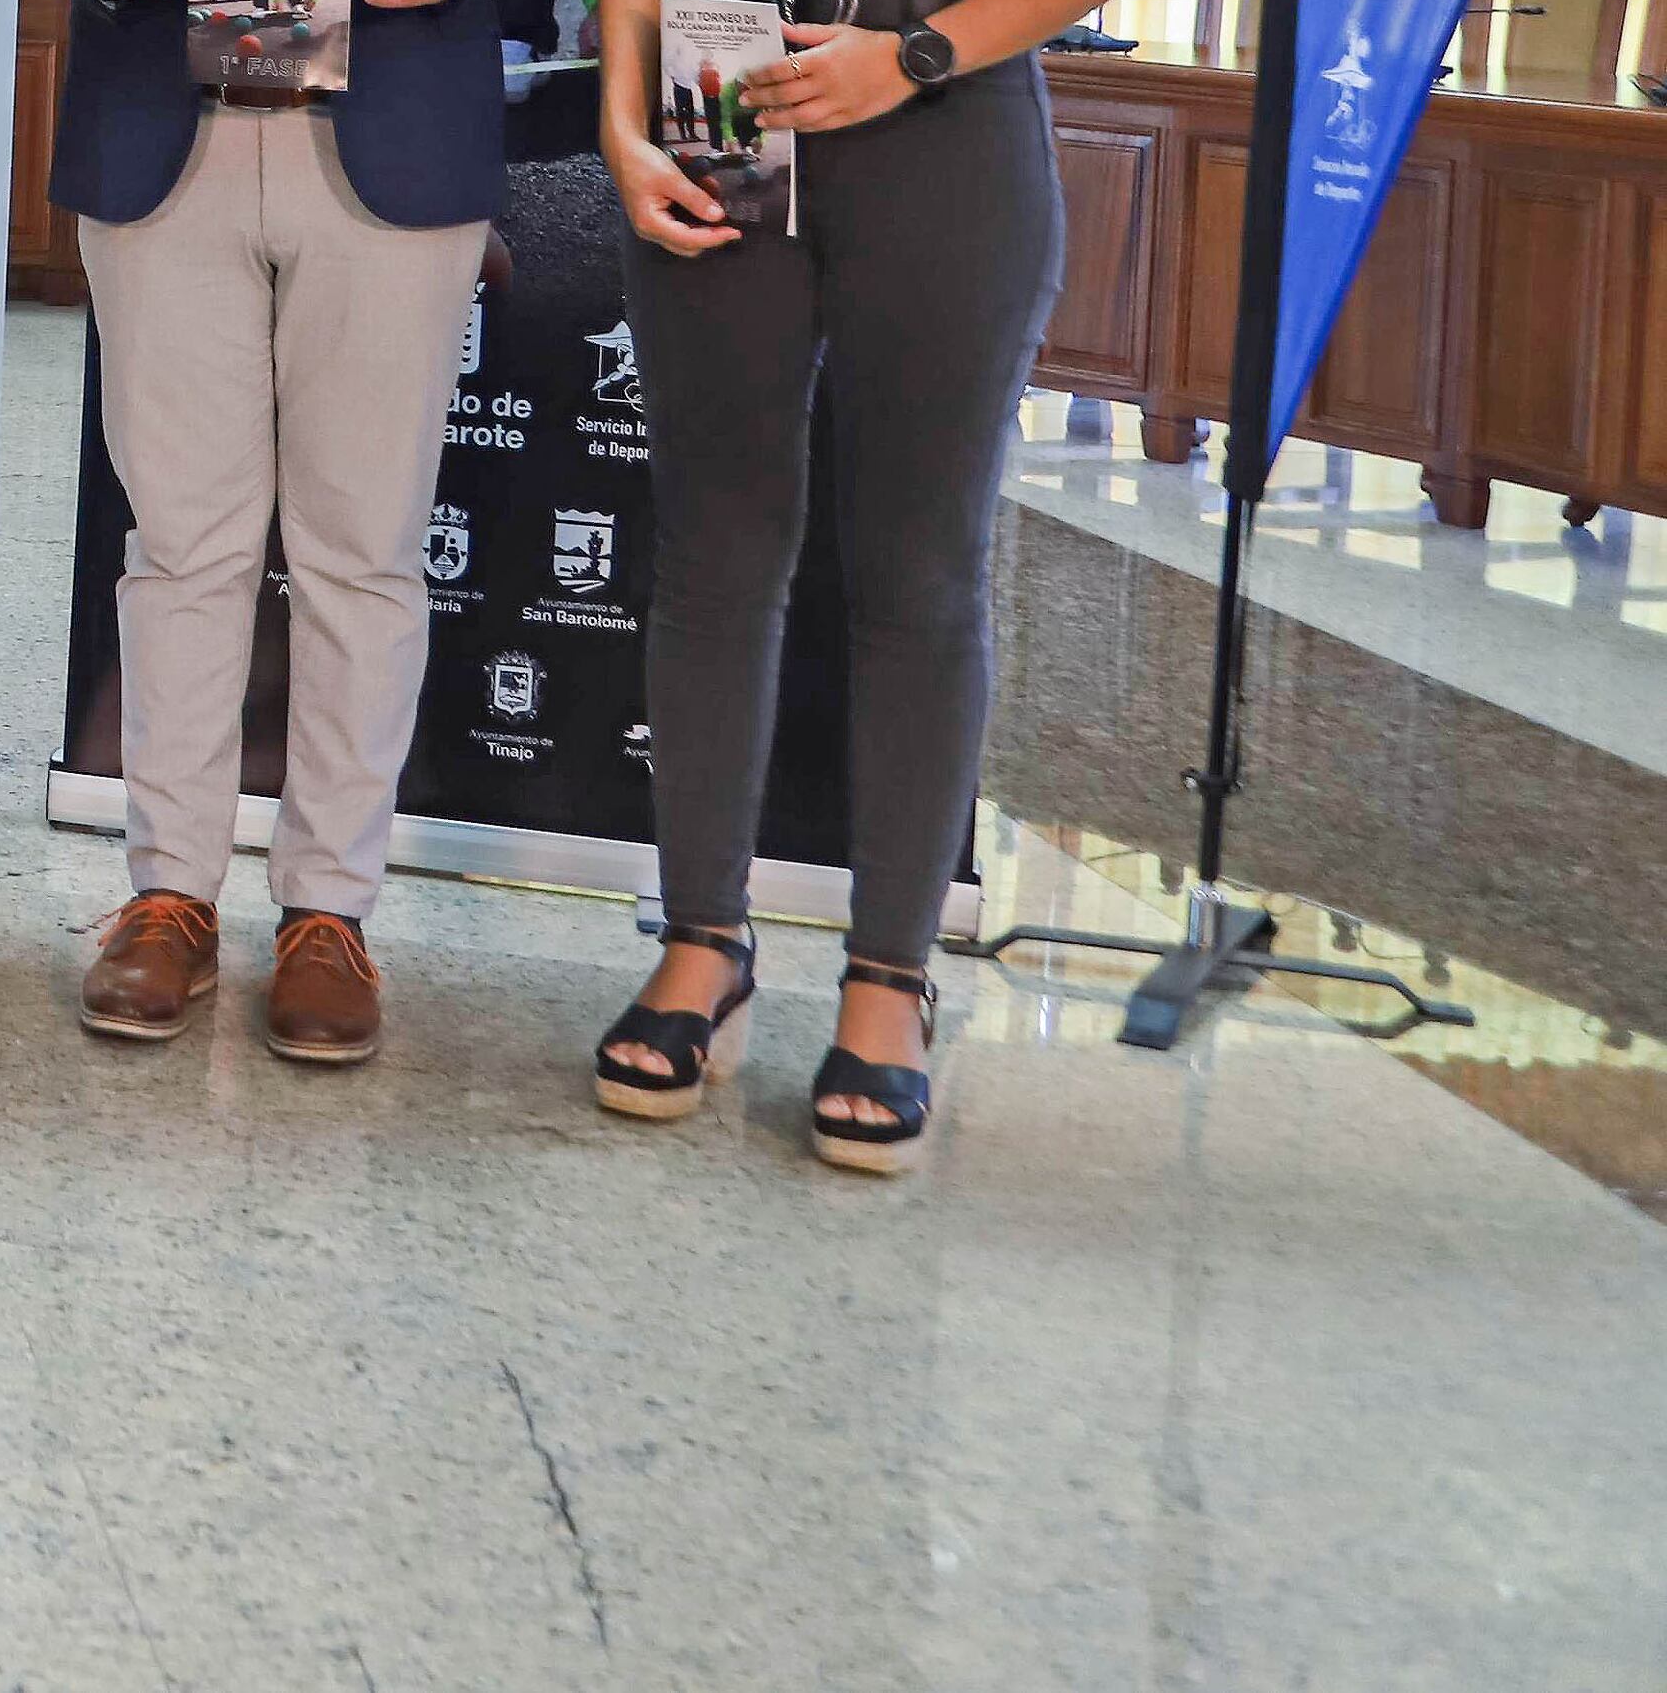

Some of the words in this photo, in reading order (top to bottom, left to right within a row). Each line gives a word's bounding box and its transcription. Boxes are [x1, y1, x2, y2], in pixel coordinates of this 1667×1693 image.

[247, 57, 310, 78] FASE
[492, 391, 533, 419] de
[575, 415, 633, 435] Servicio
[443, 423, 525, 449] arote
[588, 441, 606, 457] de
[609, 442, 649, 462] Depor
[522, 606, 552, 623] San
[556, 610, 638, 631] Bartolomé
[487, 741, 535, 761] Tinajo
